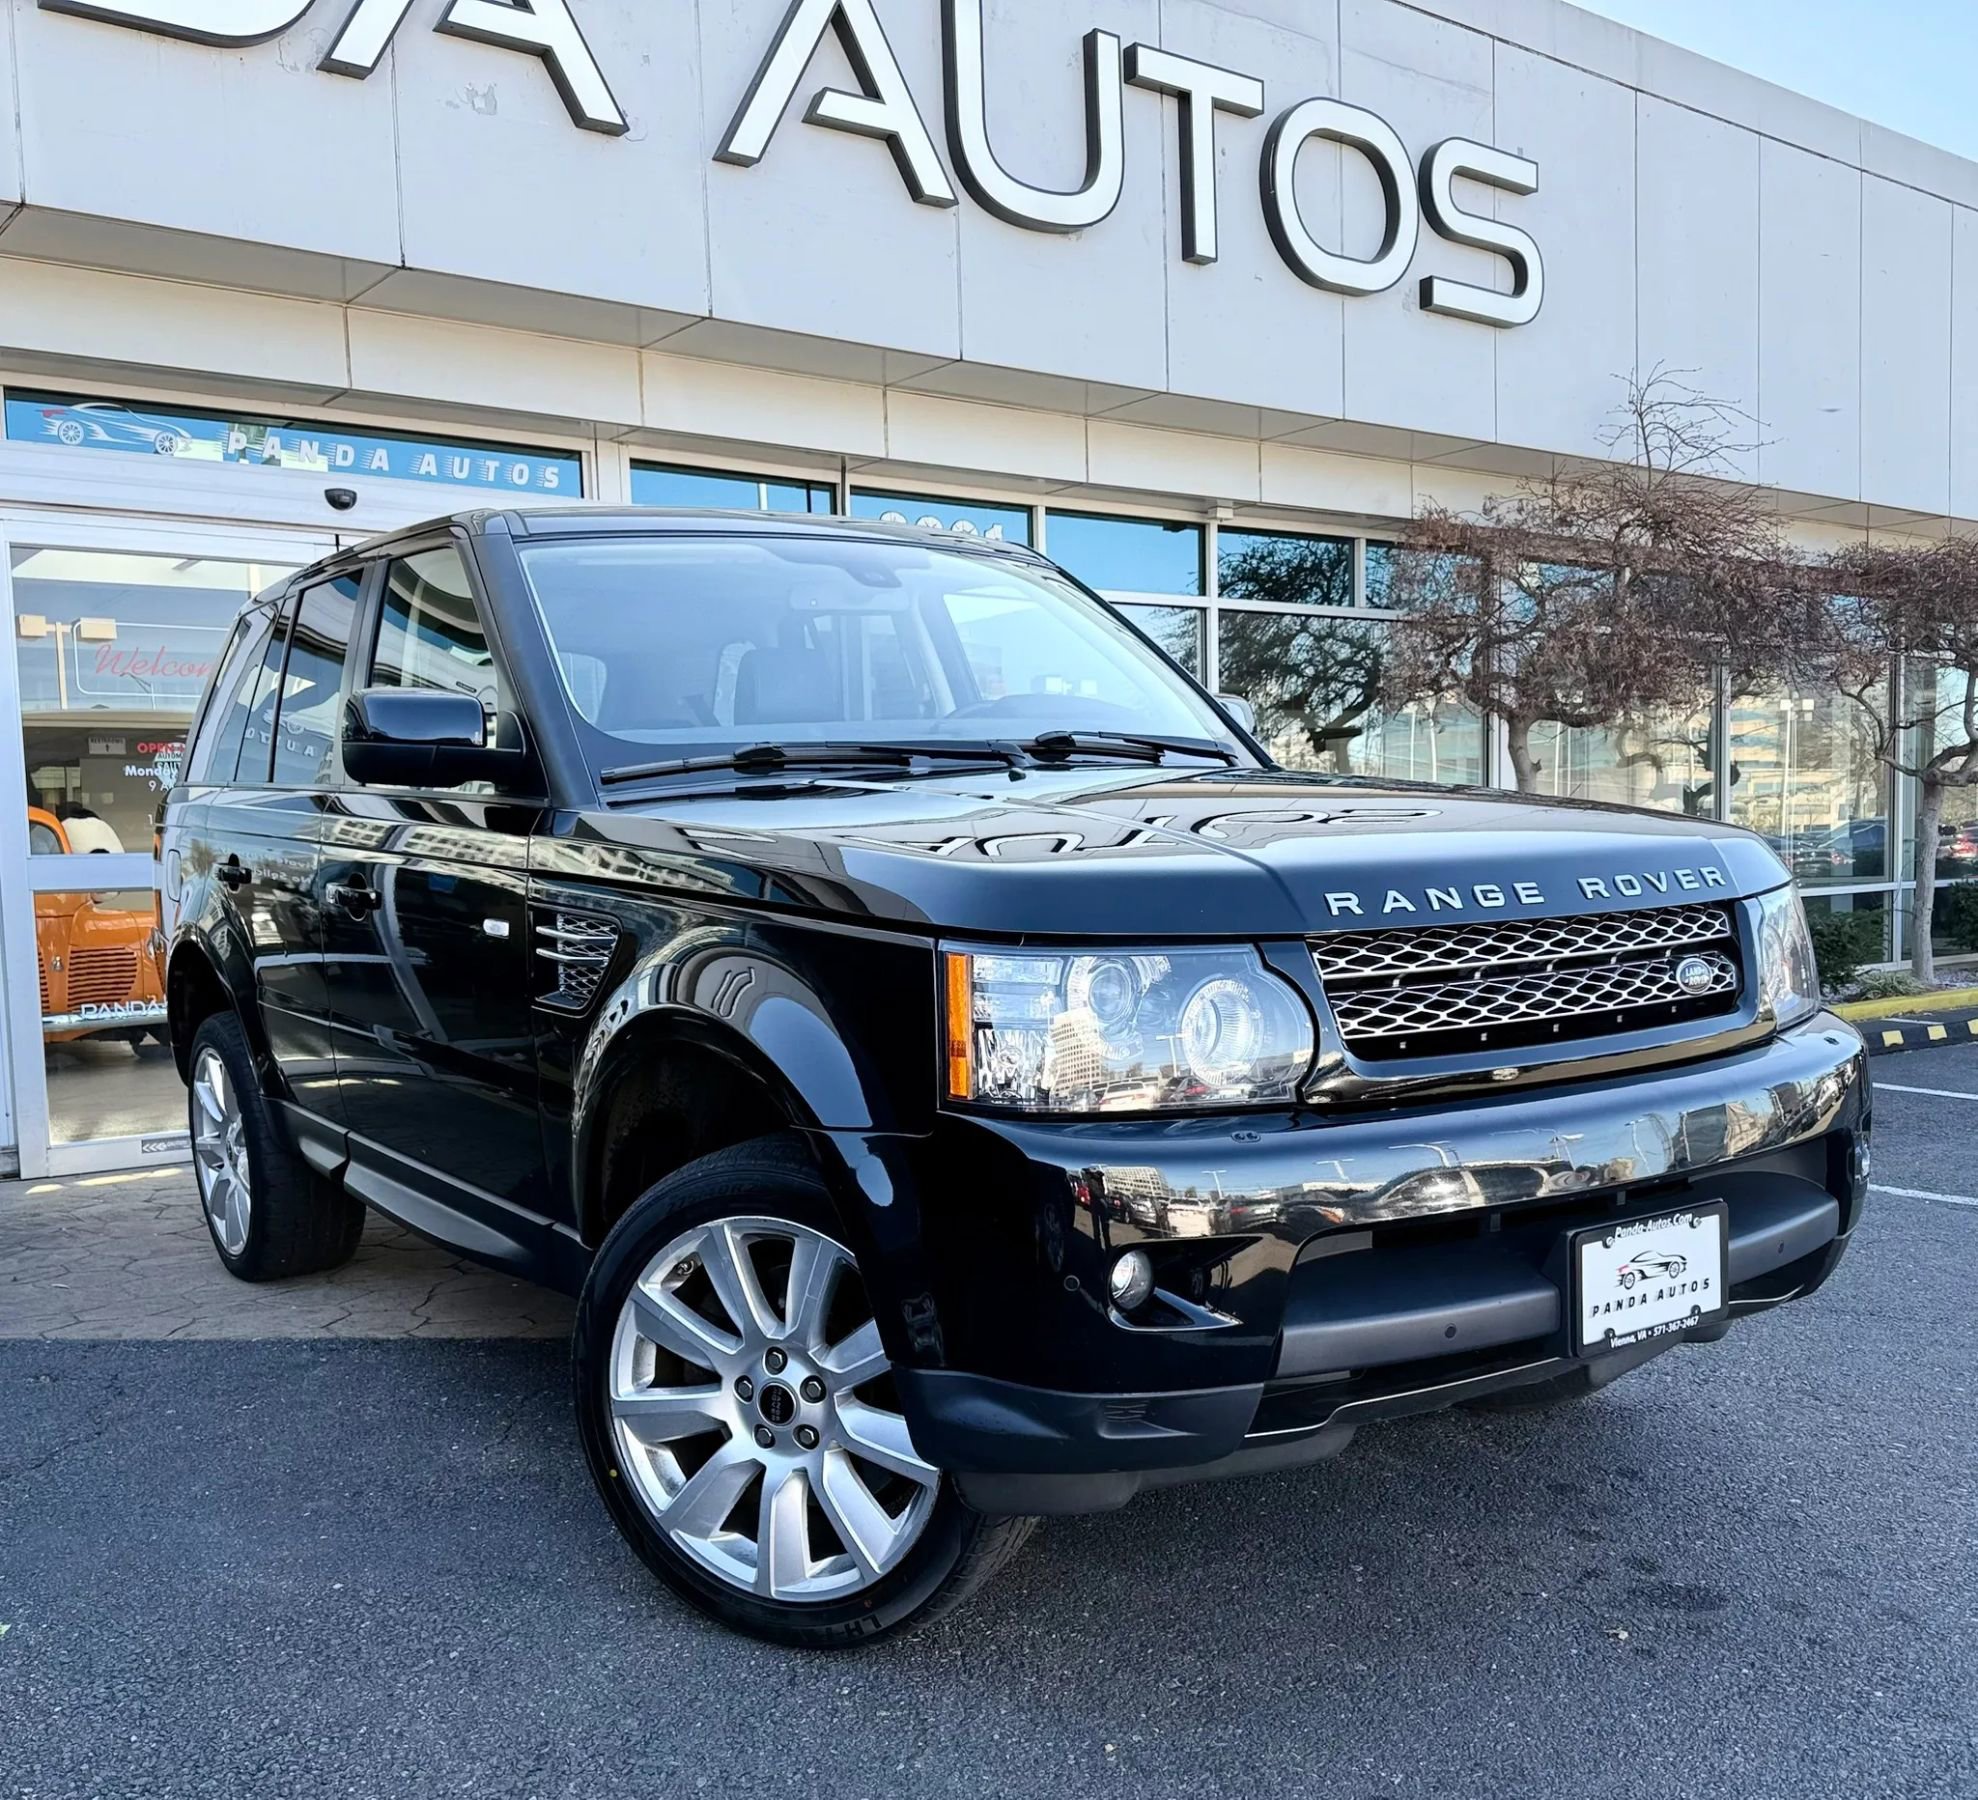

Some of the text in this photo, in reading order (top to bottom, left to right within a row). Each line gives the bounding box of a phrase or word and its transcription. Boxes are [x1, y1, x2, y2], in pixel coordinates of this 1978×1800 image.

[713, 0, 1544, 329] AUTOS
[226, 431, 561, 489] PANDA AUTOS
[1324, 866, 1727, 916] RANGE ROVER
[1591, 1278, 1710, 1317] PANDA AUTOS
